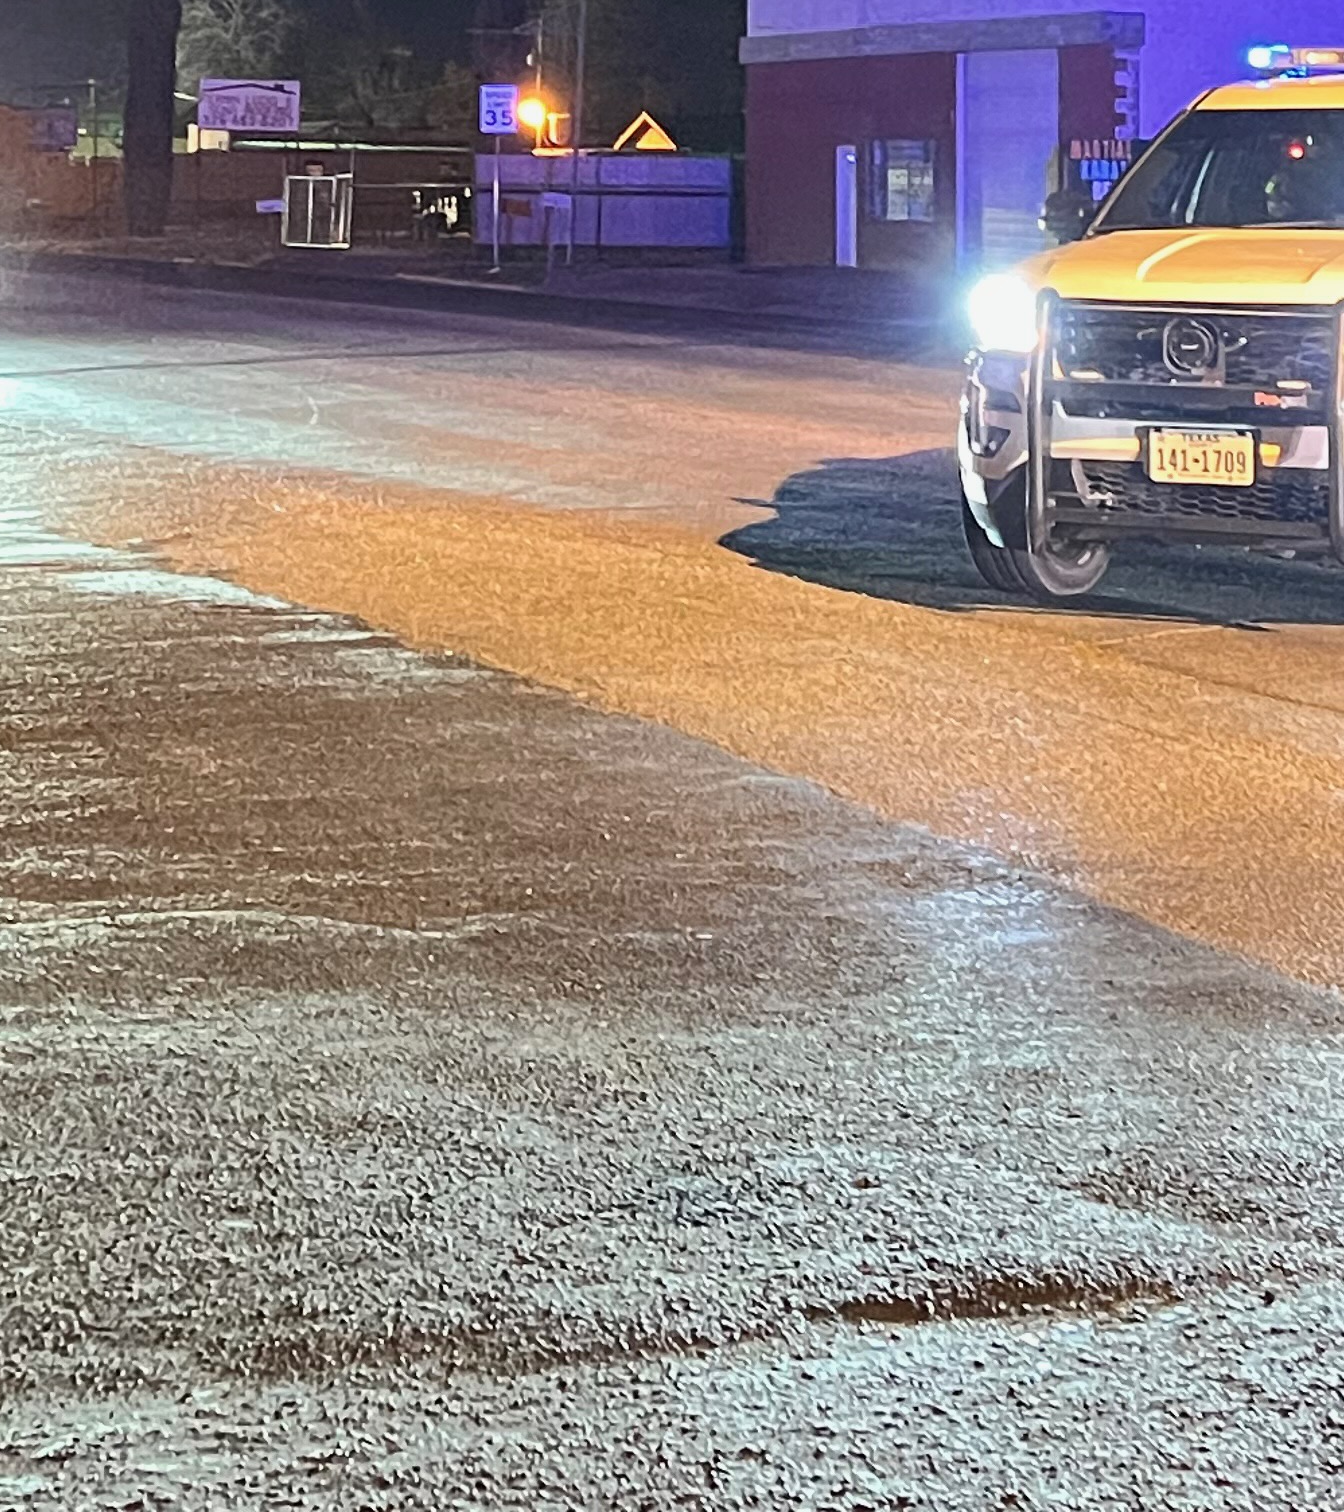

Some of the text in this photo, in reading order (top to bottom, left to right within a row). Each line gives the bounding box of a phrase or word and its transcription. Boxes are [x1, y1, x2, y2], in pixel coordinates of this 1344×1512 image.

[485, 110, 513, 127] 35
[1182, 433, 1220, 443] TEXAS
[1157, 448, 1246, 474] 141-1709
